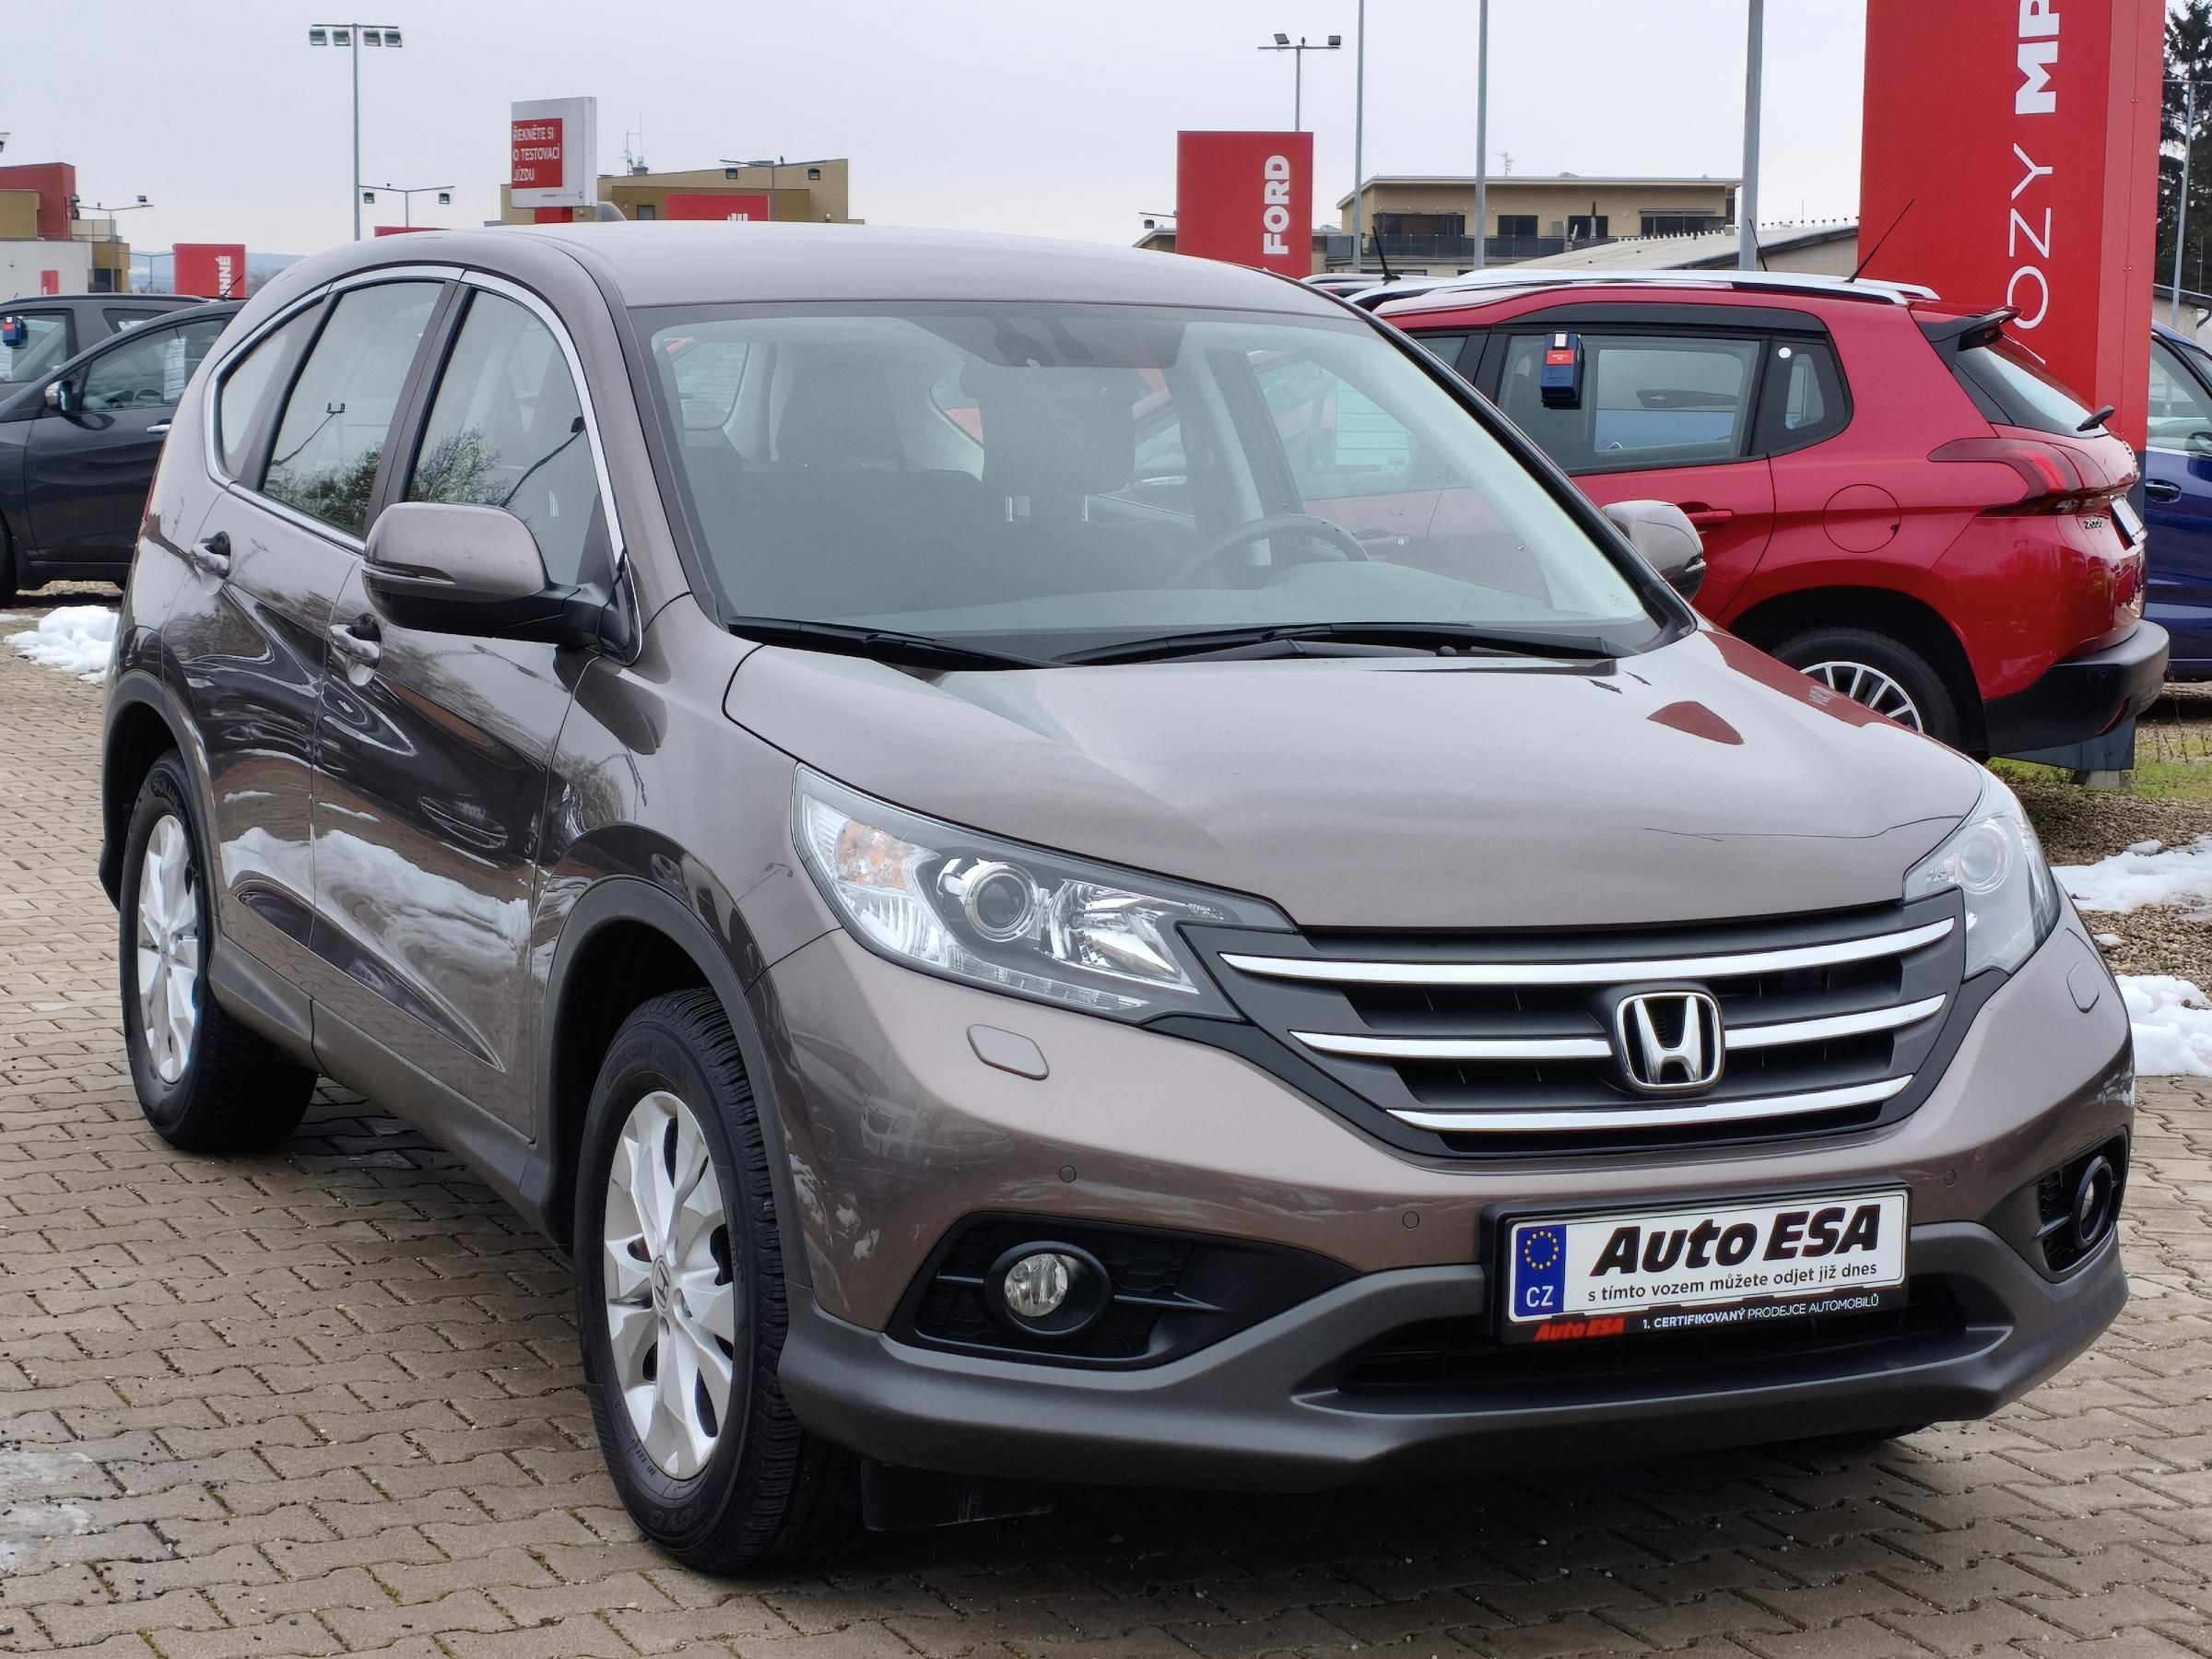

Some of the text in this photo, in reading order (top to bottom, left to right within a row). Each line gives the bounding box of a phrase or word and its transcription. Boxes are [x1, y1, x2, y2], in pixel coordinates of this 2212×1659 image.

[547, 126, 555, 140] SI
[513, 143, 560, 161] O TESTOVACÍ
[1263, 155, 1289, 254] FORD
[2006, 142, 2053, 364] OZY
[1589, 1204, 1881, 1277] Auto ESA
[1526, 1285, 1554, 1308] CZ
[1588, 1263, 1877, 1302] s tímto vozem můžete odjet již dnes
[1534, 1316, 1626, 1342] Auto ESA
[1642, 1293, 1879, 1329] 1. CERTIFIKOVANÝ PRODEJCE AUTOMOBILŮ
